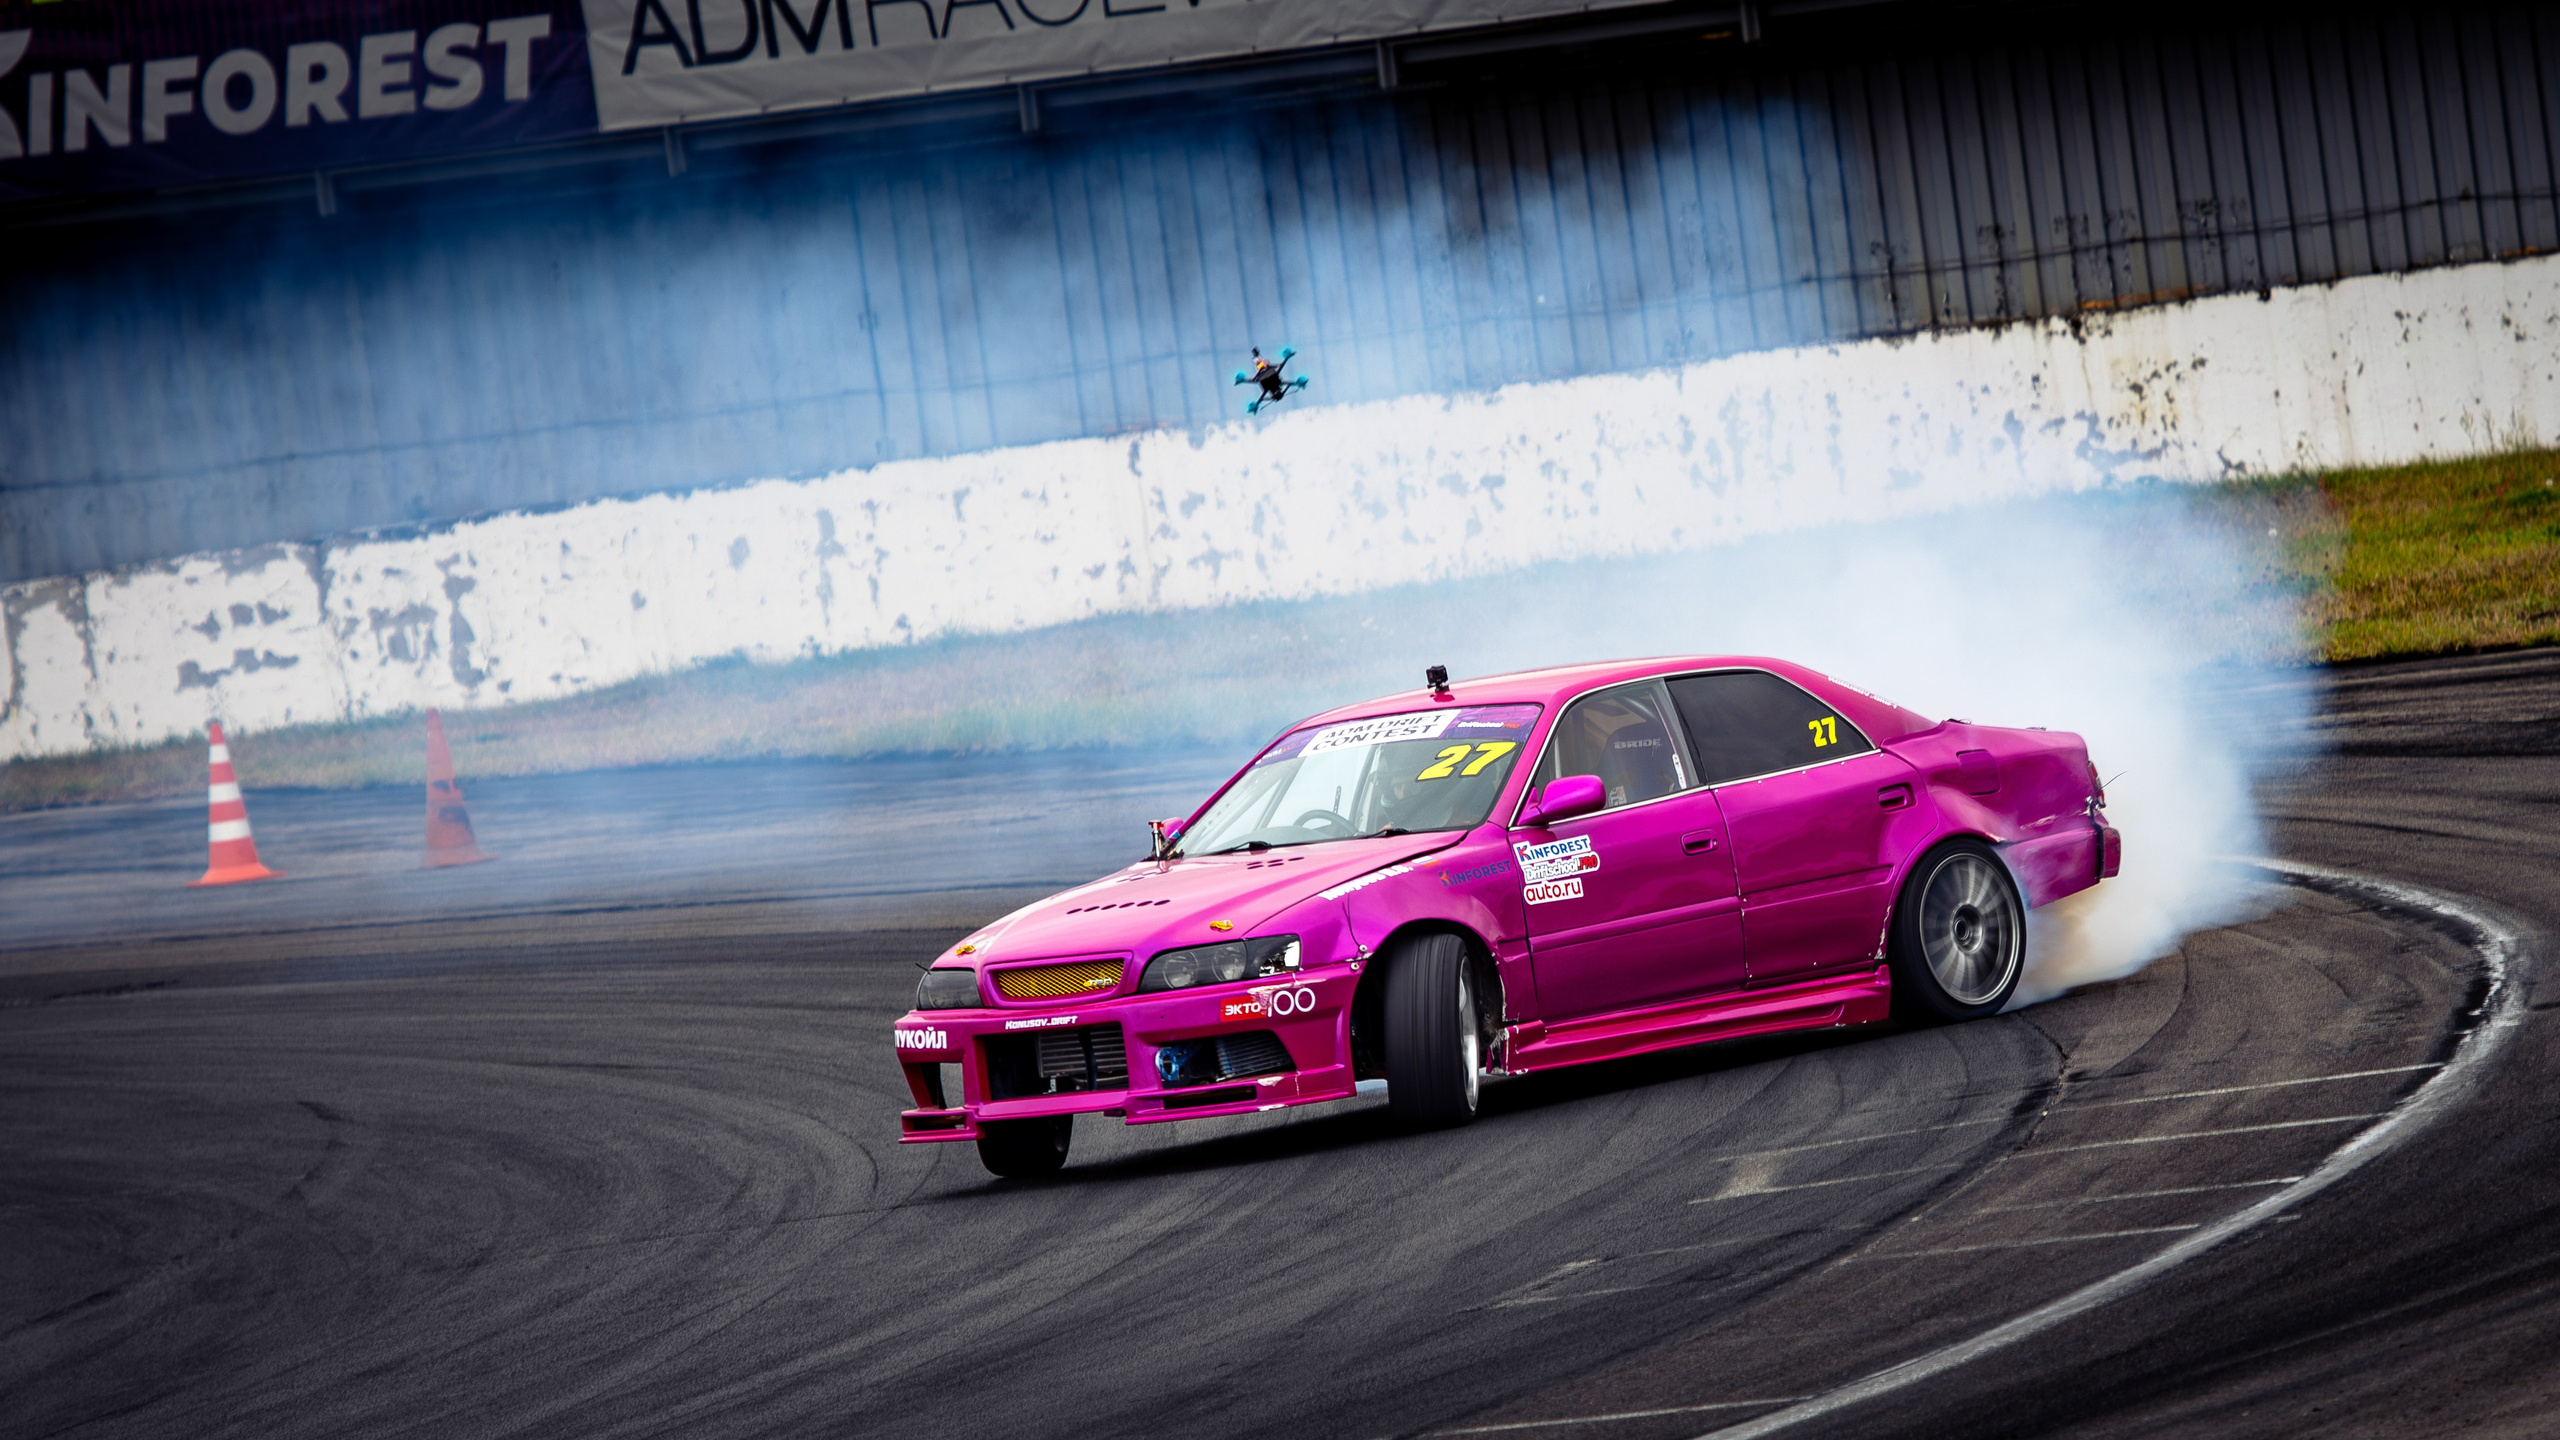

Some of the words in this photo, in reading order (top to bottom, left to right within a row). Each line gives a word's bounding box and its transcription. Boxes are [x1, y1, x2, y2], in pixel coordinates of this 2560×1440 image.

[0, 13, 552, 160] INFOREST
[1312, 724, 1437, 751] CONTEST
[1323, 723, 1374, 740] ADM
[1377, 714, 1446, 729] DRIFT
[1808, 716, 1837, 748] 27
[1416, 742, 1517, 782] 27
[1516, 838, 1589, 862] KINFOREST
[1438, 860, 1511, 887] KINFOREST
[1526, 881, 1581, 902] auto.ru
